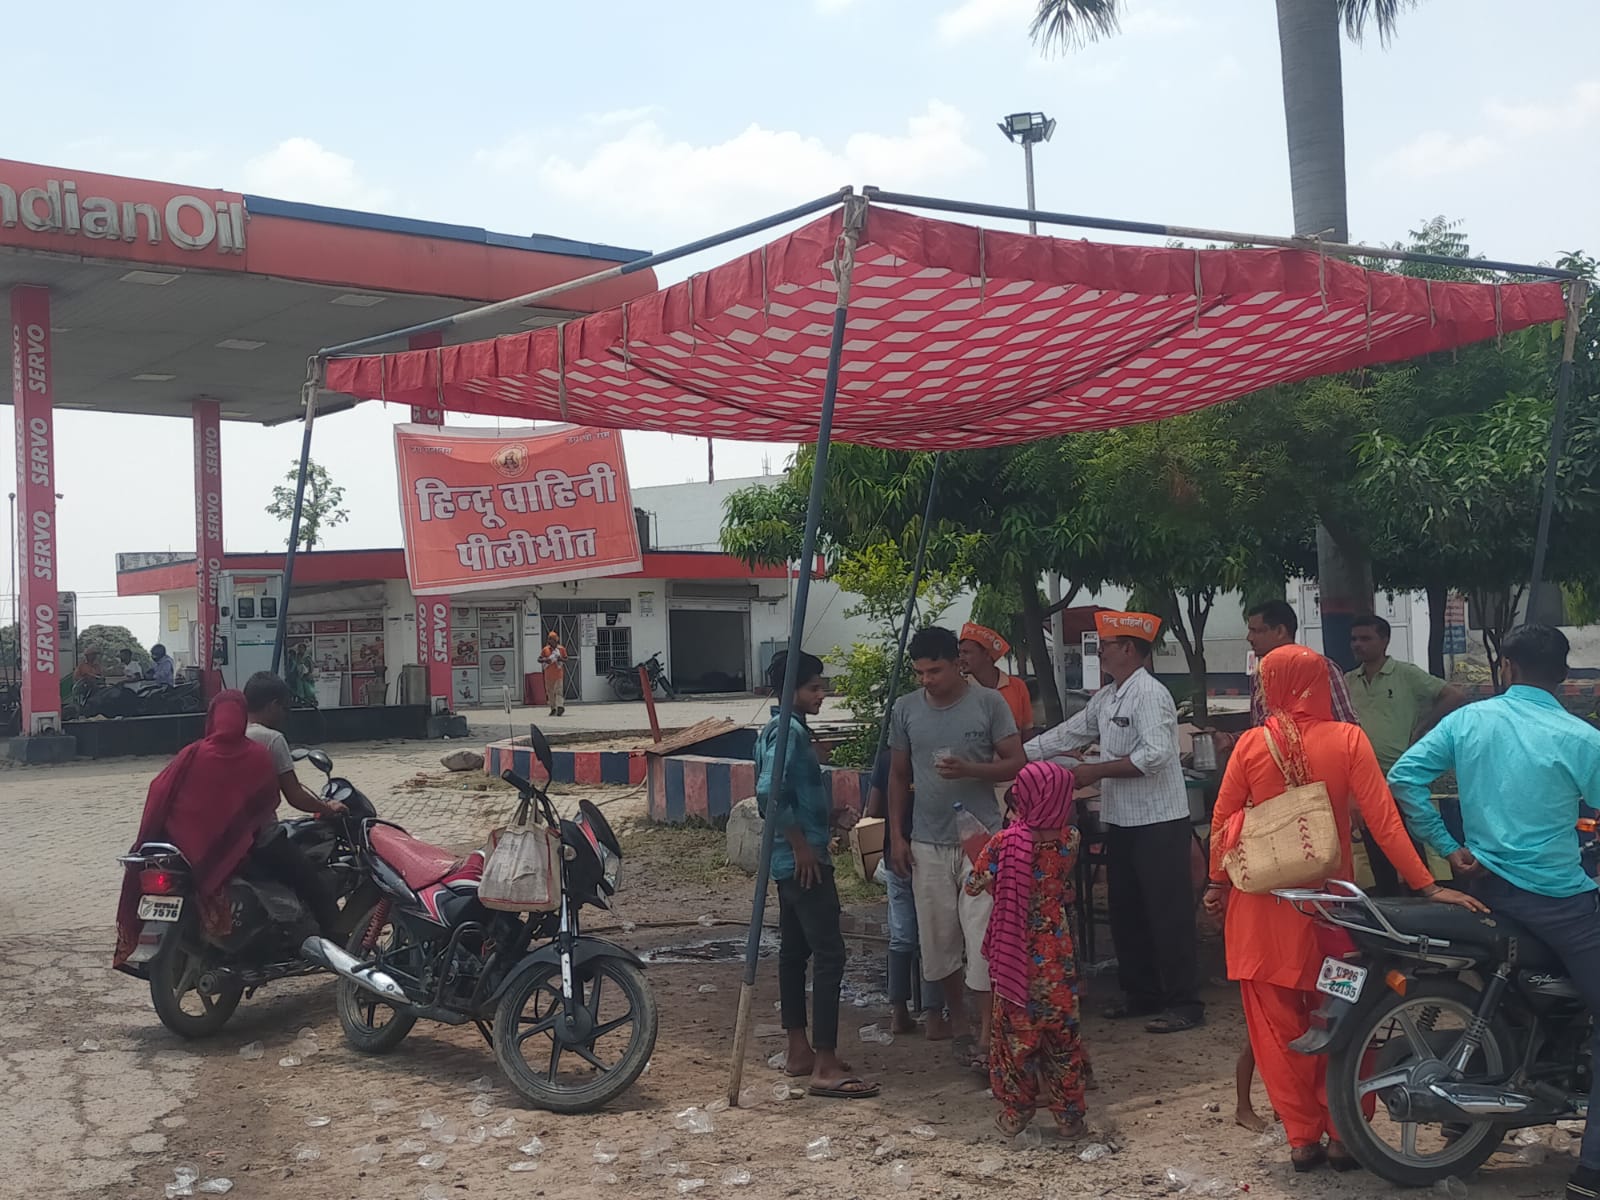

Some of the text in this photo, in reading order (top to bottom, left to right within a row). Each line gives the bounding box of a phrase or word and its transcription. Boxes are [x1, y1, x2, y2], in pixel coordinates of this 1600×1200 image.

[13, 325, 23, 392] SERVO
[27, 323, 46, 395] SERVO
[30, 417, 49, 487] SERVO
[205, 427, 218, 475] SERVO
[207, 492, 220, 541] SERVO
[415, 462, 617, 528] हिन्दू वाहिनी
[33, 510, 52, 581] SERVO
[456, 524, 597, 572] पीलीभीत
[21, 605, 30, 673] SERVO
[36, 604, 55, 674] SERVO
[419, 603, 429, 663] SERVO
[433, 603, 449, 663] SERVO
[152, 909, 178, 918] 7576
